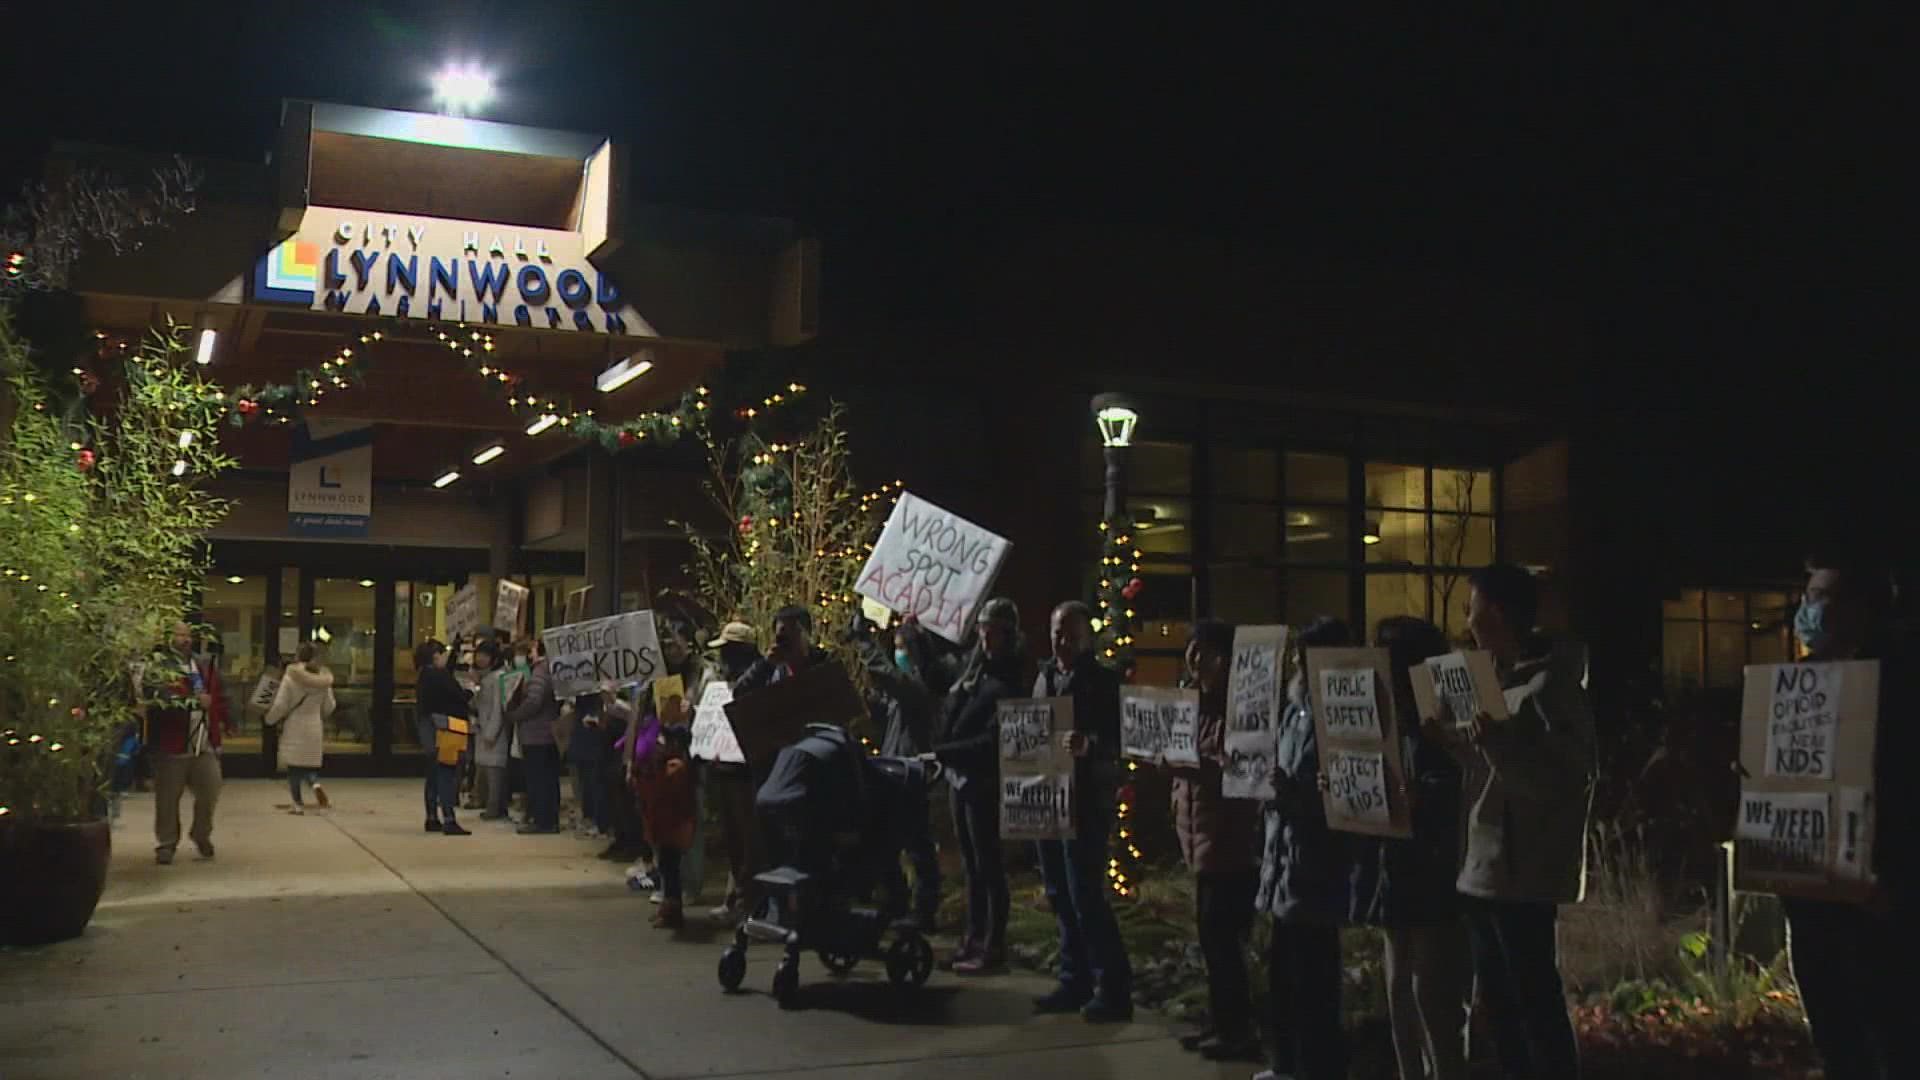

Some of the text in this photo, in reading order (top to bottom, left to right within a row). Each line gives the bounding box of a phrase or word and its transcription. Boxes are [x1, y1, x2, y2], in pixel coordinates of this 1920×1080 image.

[334, 221, 552, 264] CITY HALL
[325, 247, 622, 312] LYNNWOOD
[902, 505, 993, 575] WRONG
[899, 549, 961, 598] SPOT
[860, 565, 964, 635] ACADIA
[557, 624, 621, 655] PROTECT
[594, 646, 656, 681] KIDS
[1236, 648, 1262, 671] NO
[1326, 674, 1366, 697] PUBLIC
[1776, 666, 1817, 694] NO
[1325, 705, 1375, 727] SAFETY
[1328, 753, 1380, 779] PROTECT
[1776, 747, 1825, 775] KIDS
[1005, 781, 1053, 804] WE NEED
[1331, 773, 1358, 800] OUR
[1346, 783, 1384, 813] KIDS
[1745, 800, 1825, 840] WE NEED
